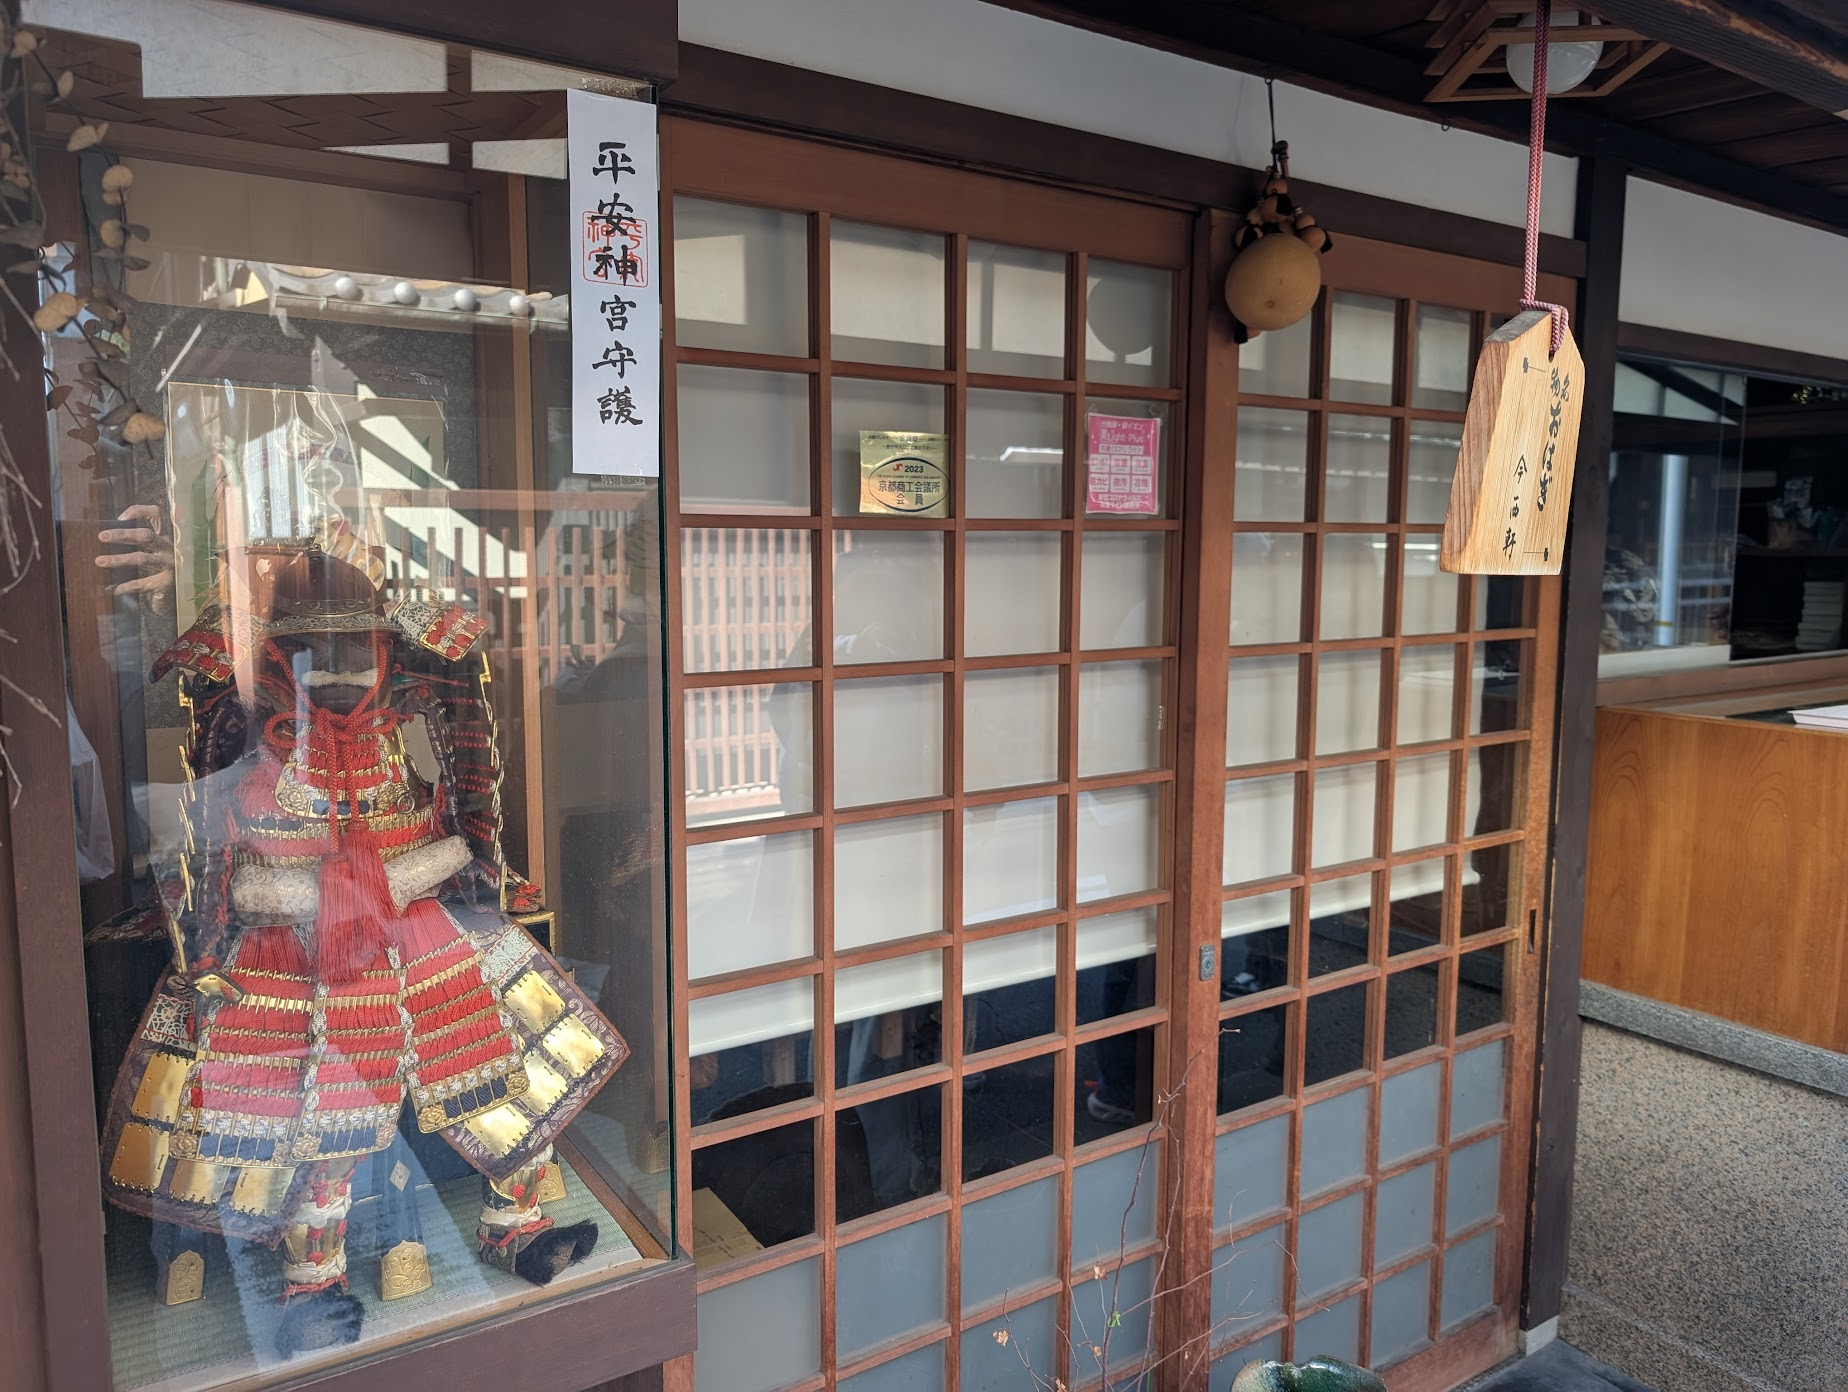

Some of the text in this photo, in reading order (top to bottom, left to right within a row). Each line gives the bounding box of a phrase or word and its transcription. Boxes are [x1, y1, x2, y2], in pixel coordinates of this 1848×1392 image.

[592, 141, 643, 426] 平安神宮守護
[904, 465, 924, 474] 2023
[878, 480, 941, 494] 京都商工会議所
